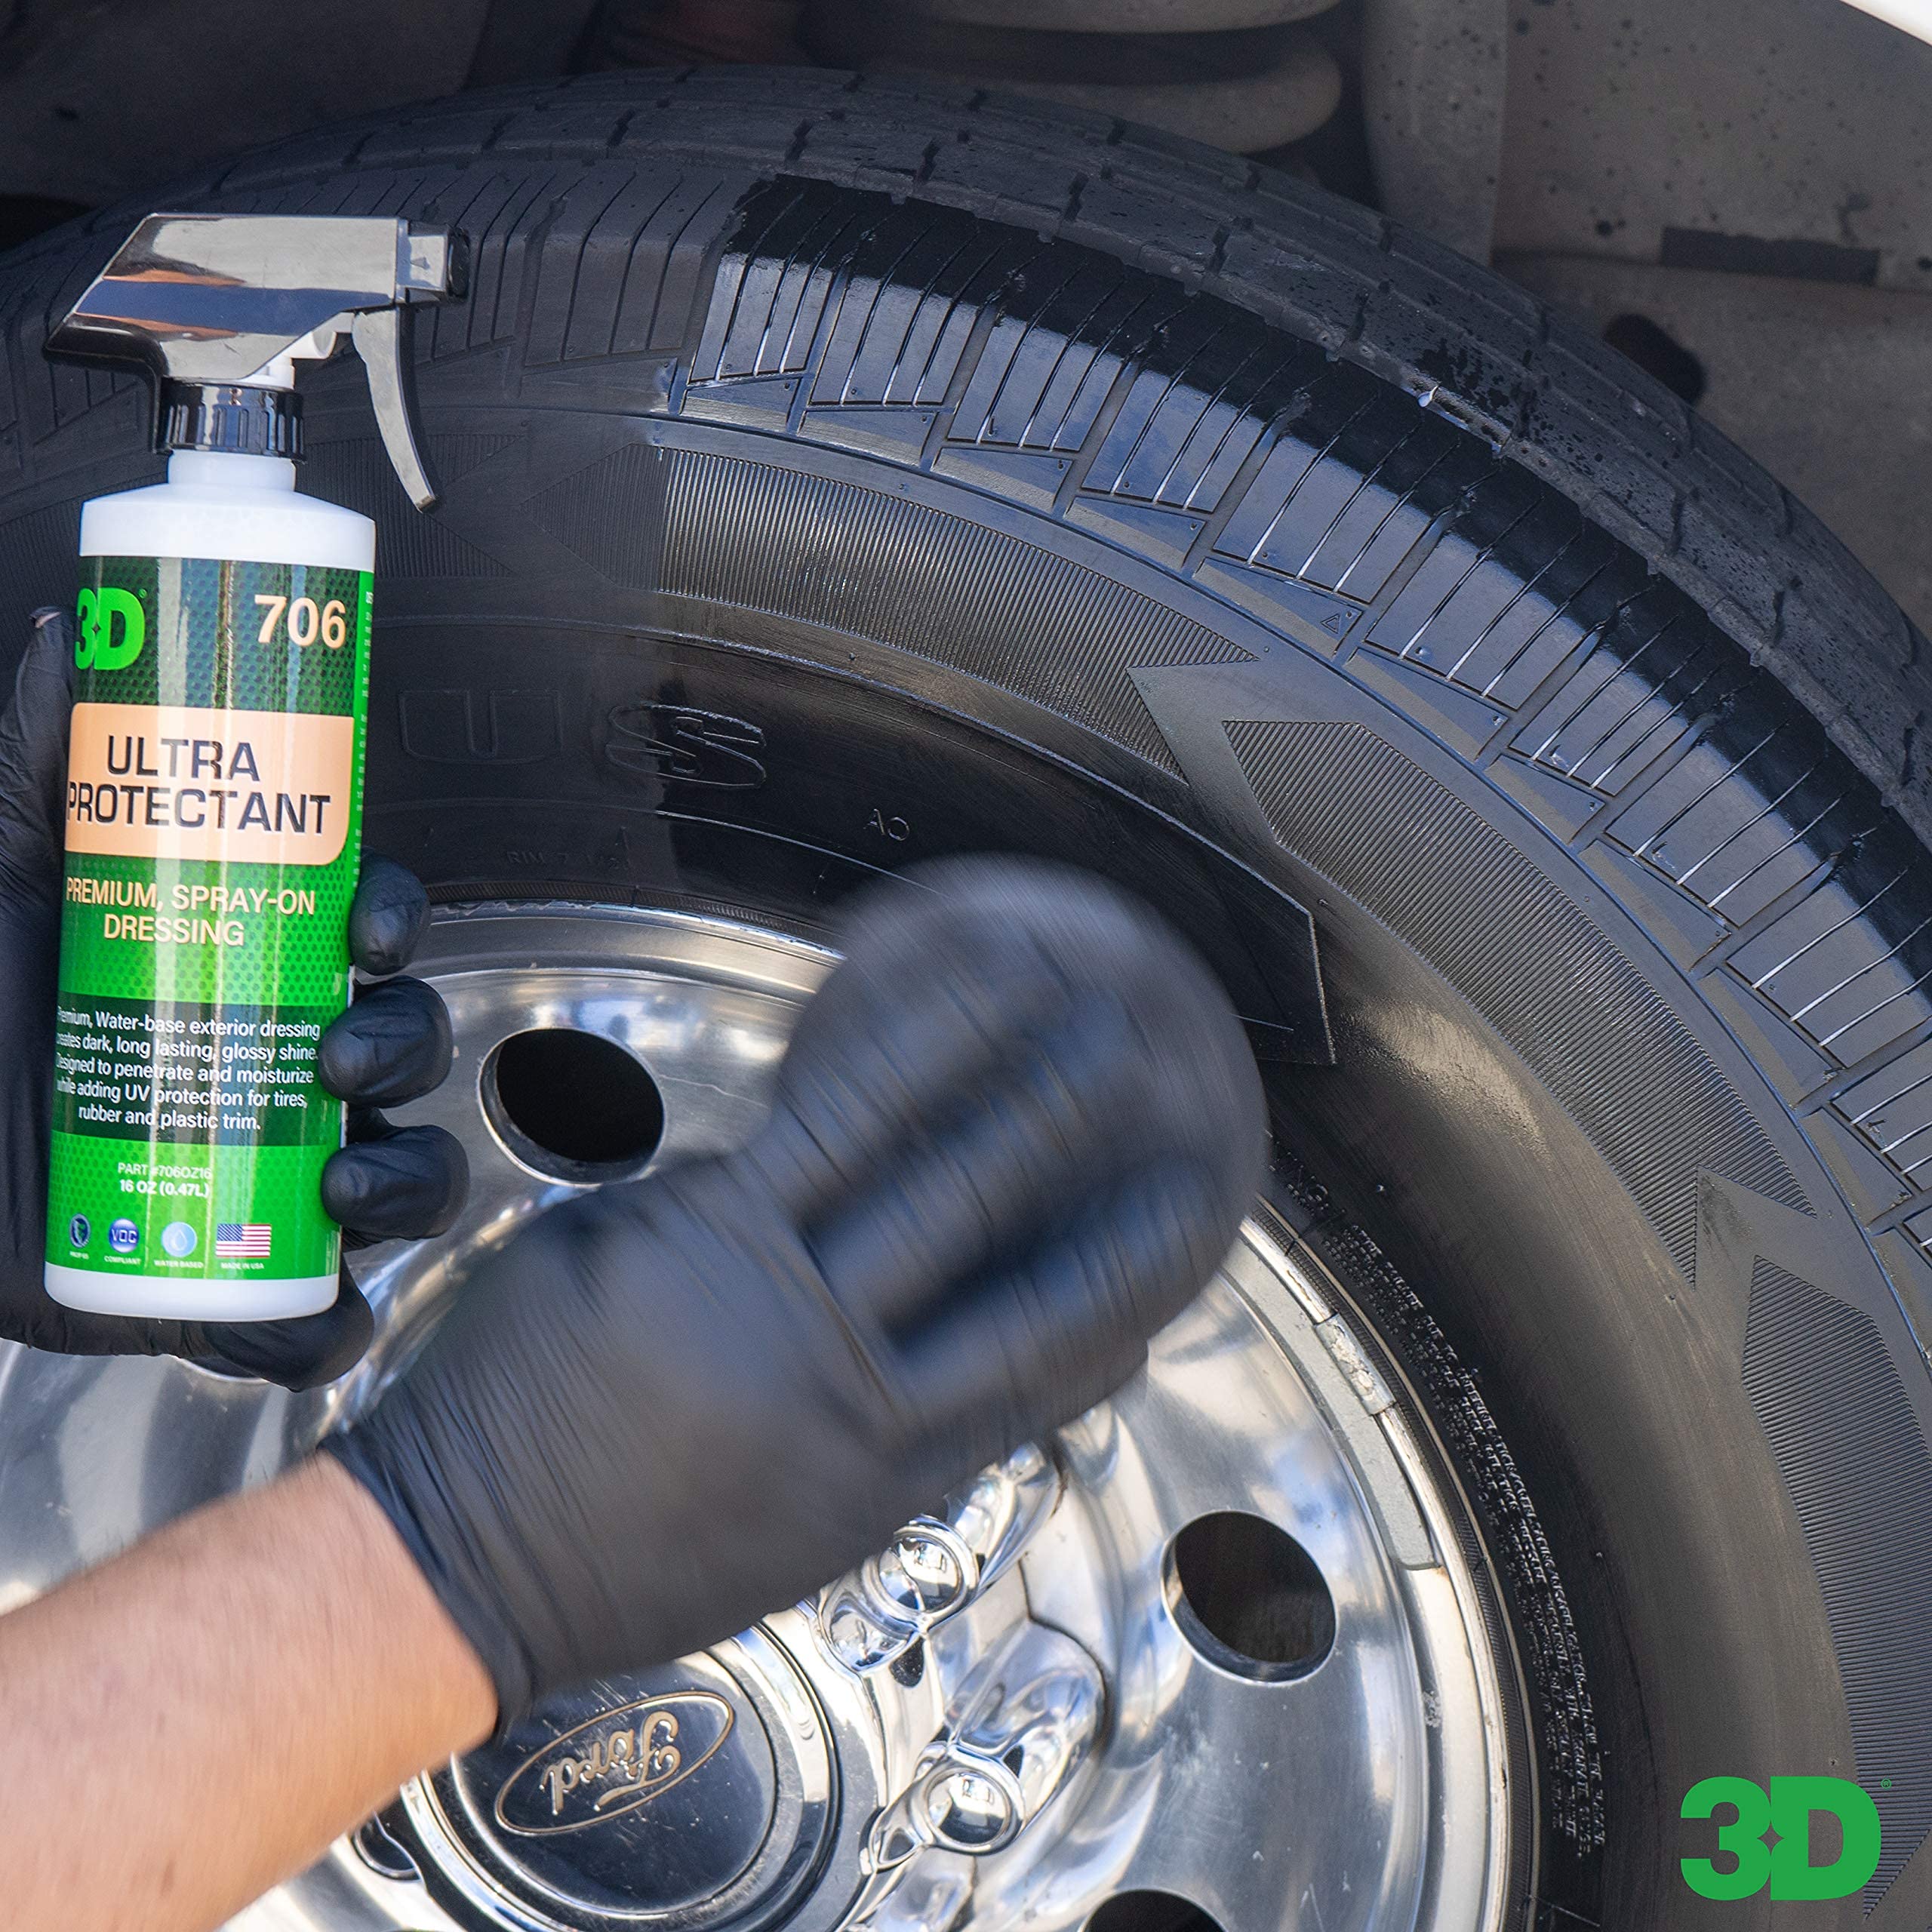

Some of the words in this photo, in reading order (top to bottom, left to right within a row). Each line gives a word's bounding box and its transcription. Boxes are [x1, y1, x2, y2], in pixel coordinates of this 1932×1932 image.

[75, 587, 145, 670] 3D
[254, 594, 346, 648] 706
[107, 735, 260, 782] ULTRA
[66, 781, 331, 835] PROTECTANT
[66, 876, 163, 912] PREMIUM,
[171, 884, 316, 915] SPRAY-ON
[103, 913, 245, 946] DRESSING
[95, 1011, 186, 1033] Water-base
[189, 1018, 256, 1037] exterior
[260, 1020, 321, 1041] dressing
[82, 1032, 113, 1054] dark,
[116, 1035, 151, 1059] long
[155, 1038, 217, 1062] lasting,
[222, 1042, 276, 1064] glossy
[97, 1059, 112, 1075] to
[115, 1062, 194, 1081] penetrate
[198, 1066, 232, 1082] and
[237, 1066, 314, 1084] moisturize
[77, 1079, 121, 1104] adding
[125, 1083, 151, 1102] UV
[154, 1088, 243, 1106] protection
[247, 1089, 270, 1106] for
[273, 1091, 308, 1109] tires,
[78, 1103, 122, 1123] rubber
[125, 1109, 156, 1125] and
[160, 1110, 219, 1130] plastic
[223, 1112, 261, 1131] trim.
[118, 1162, 148, 1176] PART
[120, 1179, 134, 1192] 16
[136, 1180, 157, 1195] OZ
[159, 1180, 211, 1198] (0.47L)
[111, 1228, 137, 1244] VOC
[103, 1255, 141, 1266] COMPLIANT
[153, 1260, 178, 1268] WATER
[180, 1260, 205, 1269] BASED
[539, 1711, 681, 1816] Ford
